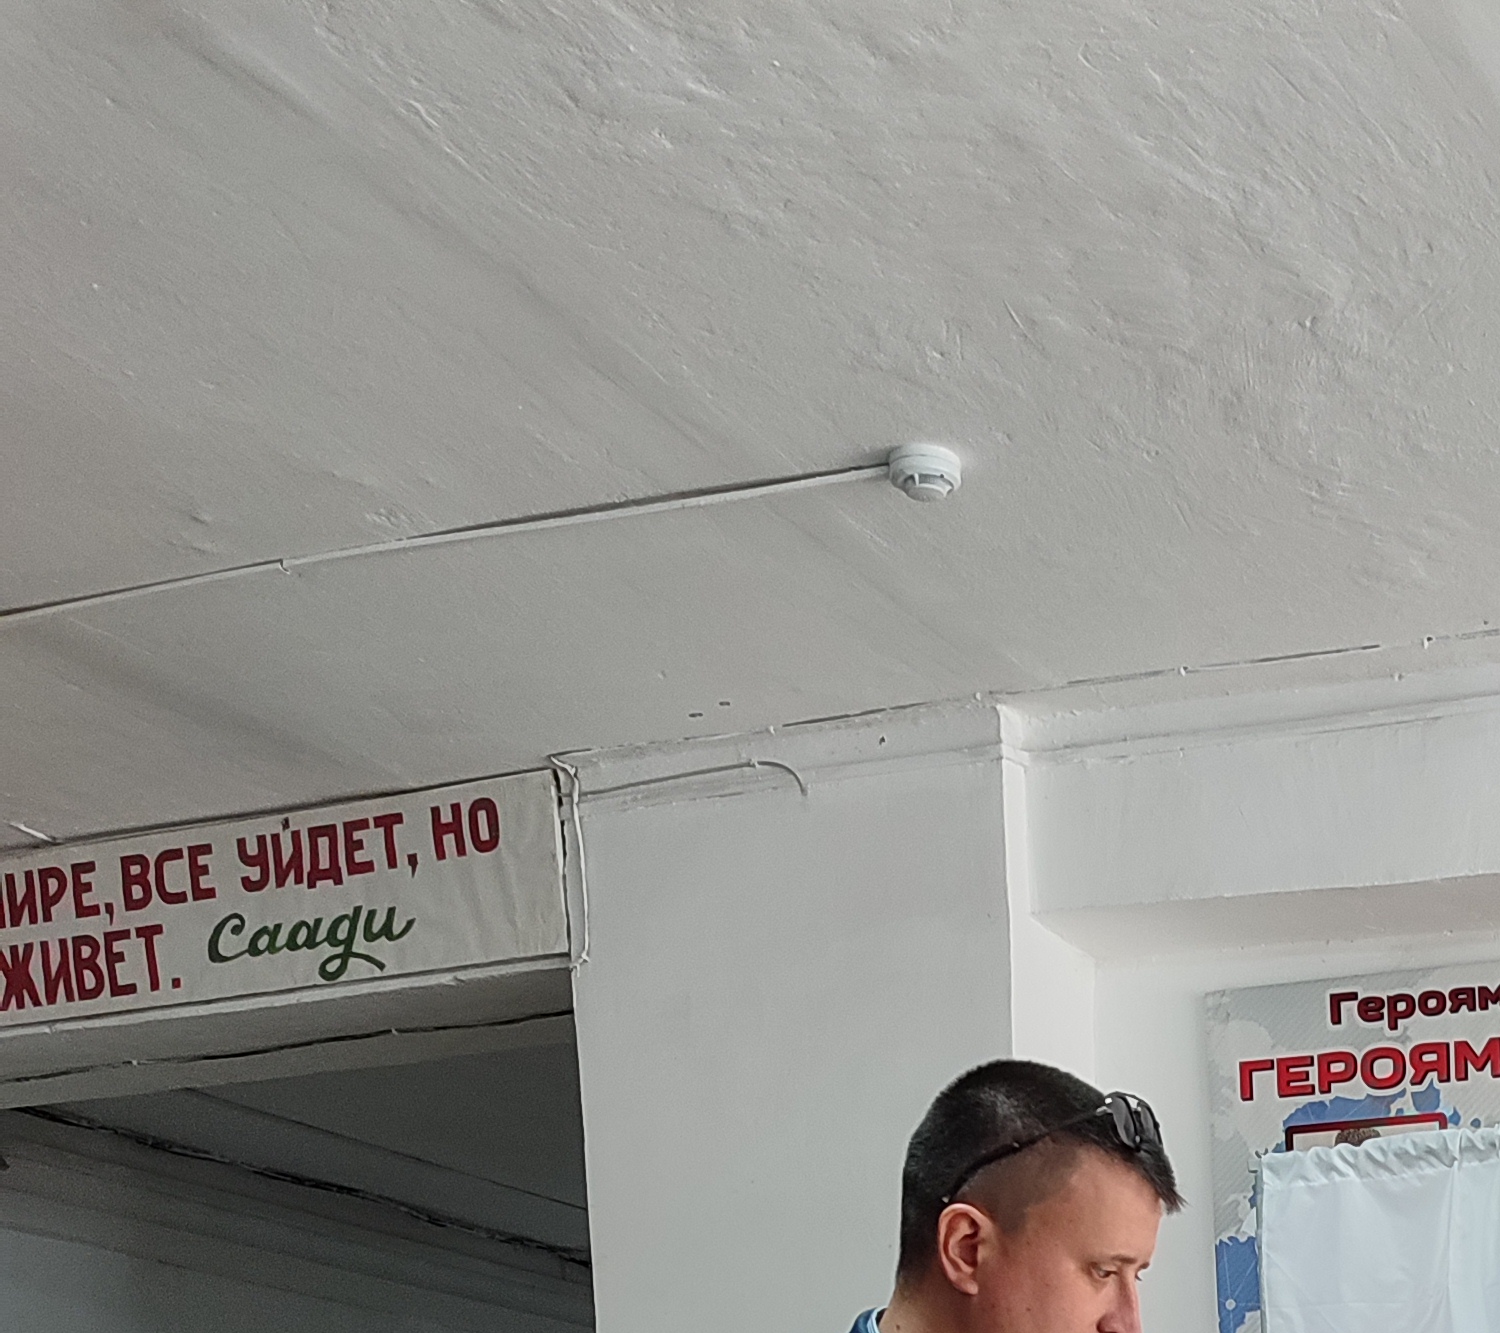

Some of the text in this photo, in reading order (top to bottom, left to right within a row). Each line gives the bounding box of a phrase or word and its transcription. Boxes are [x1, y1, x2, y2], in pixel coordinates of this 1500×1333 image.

[120, 843, 217, 911] ВСЕ
[236, 812, 419, 893] УЙДЕТ,
[430, 798, 501, 861] НО
[207, 905, 416, 981] Саади
